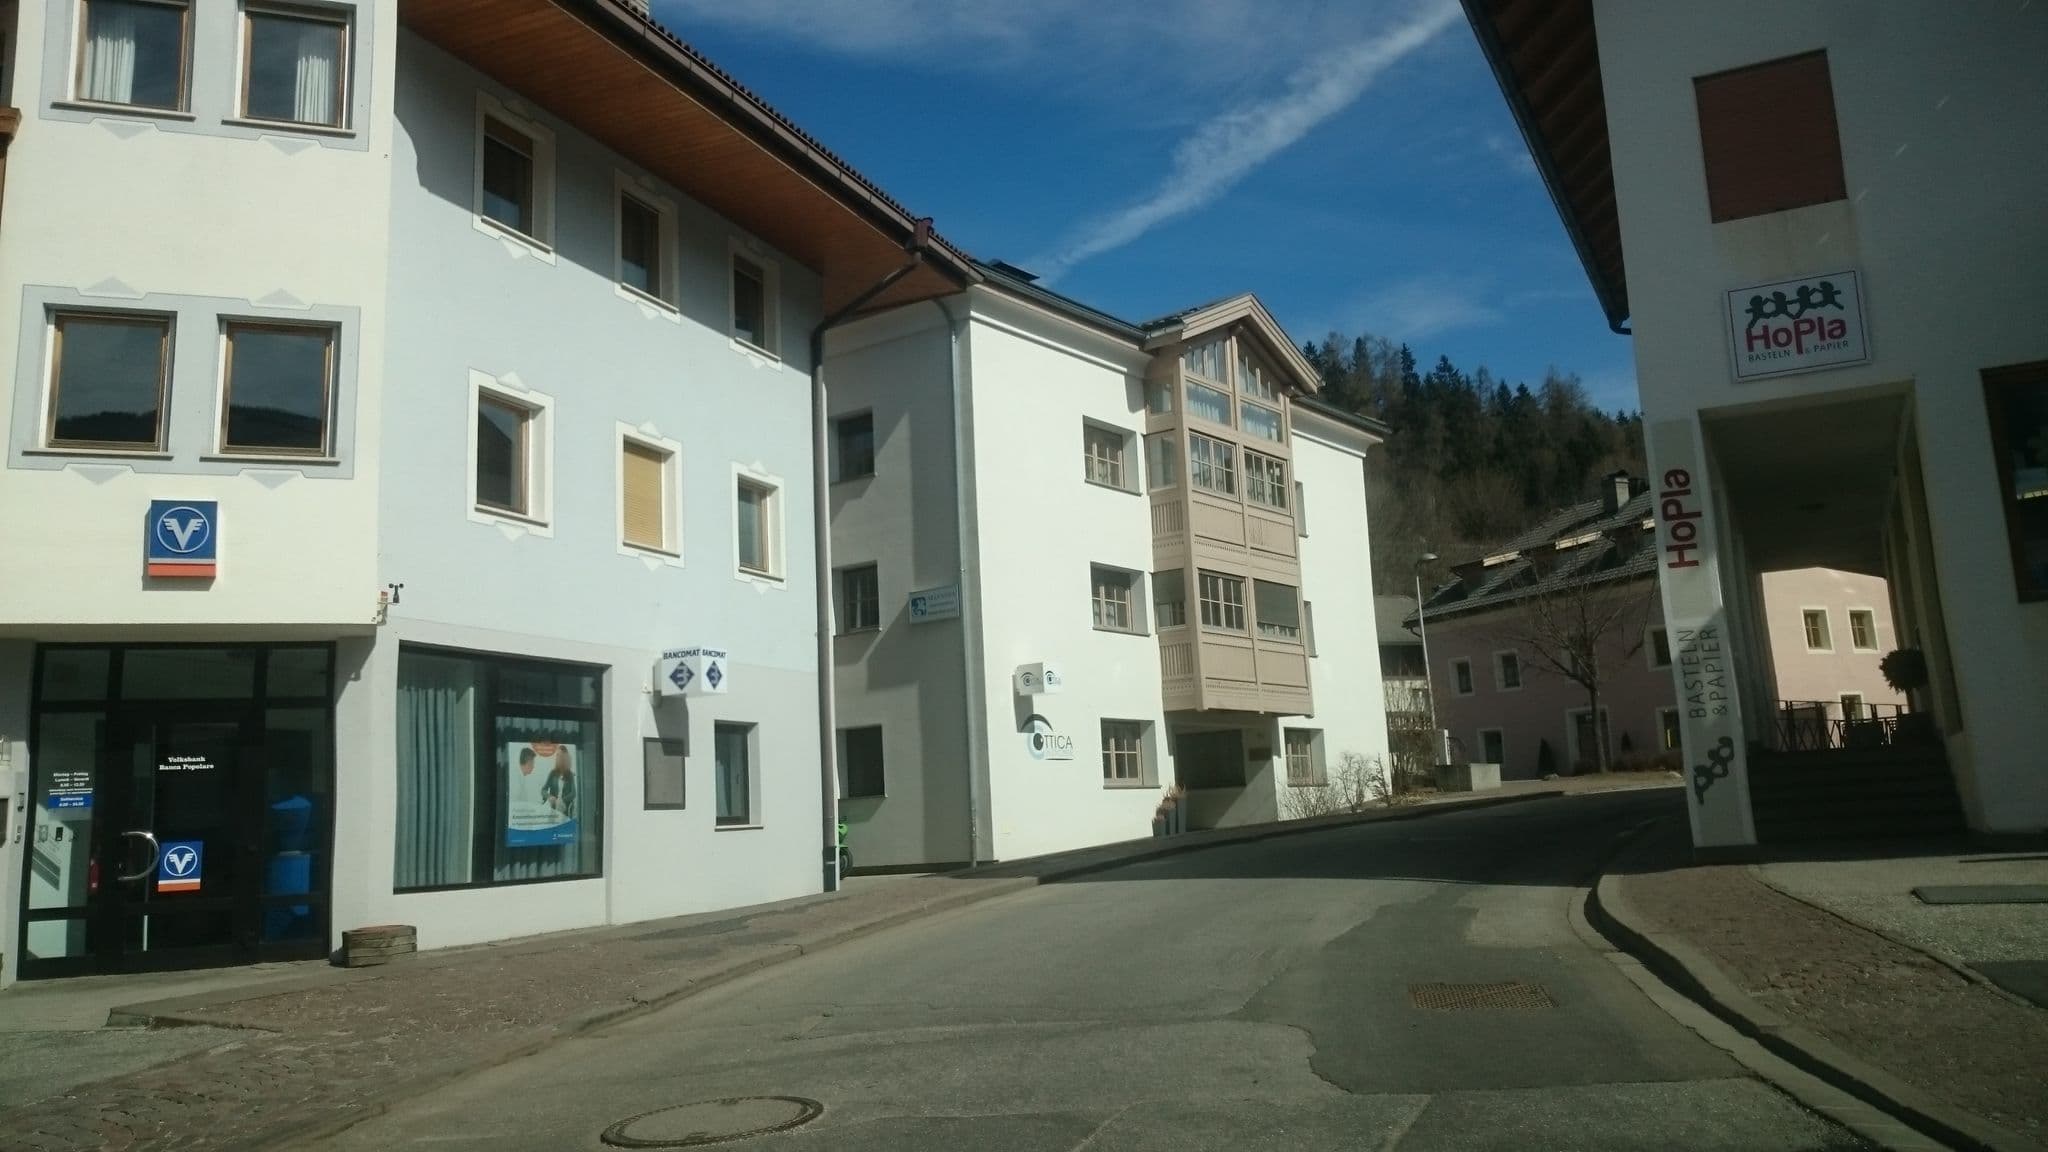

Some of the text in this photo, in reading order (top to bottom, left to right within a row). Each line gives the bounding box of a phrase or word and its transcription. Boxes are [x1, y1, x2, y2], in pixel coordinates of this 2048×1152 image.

[1745, 316, 1847, 355] HoPla
[1748, 350, 1791, 362] BASTELN
[1813, 340, 1849, 353] PAPIER
[1660, 468, 1703, 569] HoPla
[663, 649, 701, 660] BANCOMAT
[1677, 630, 1707, 718] BASTELN
